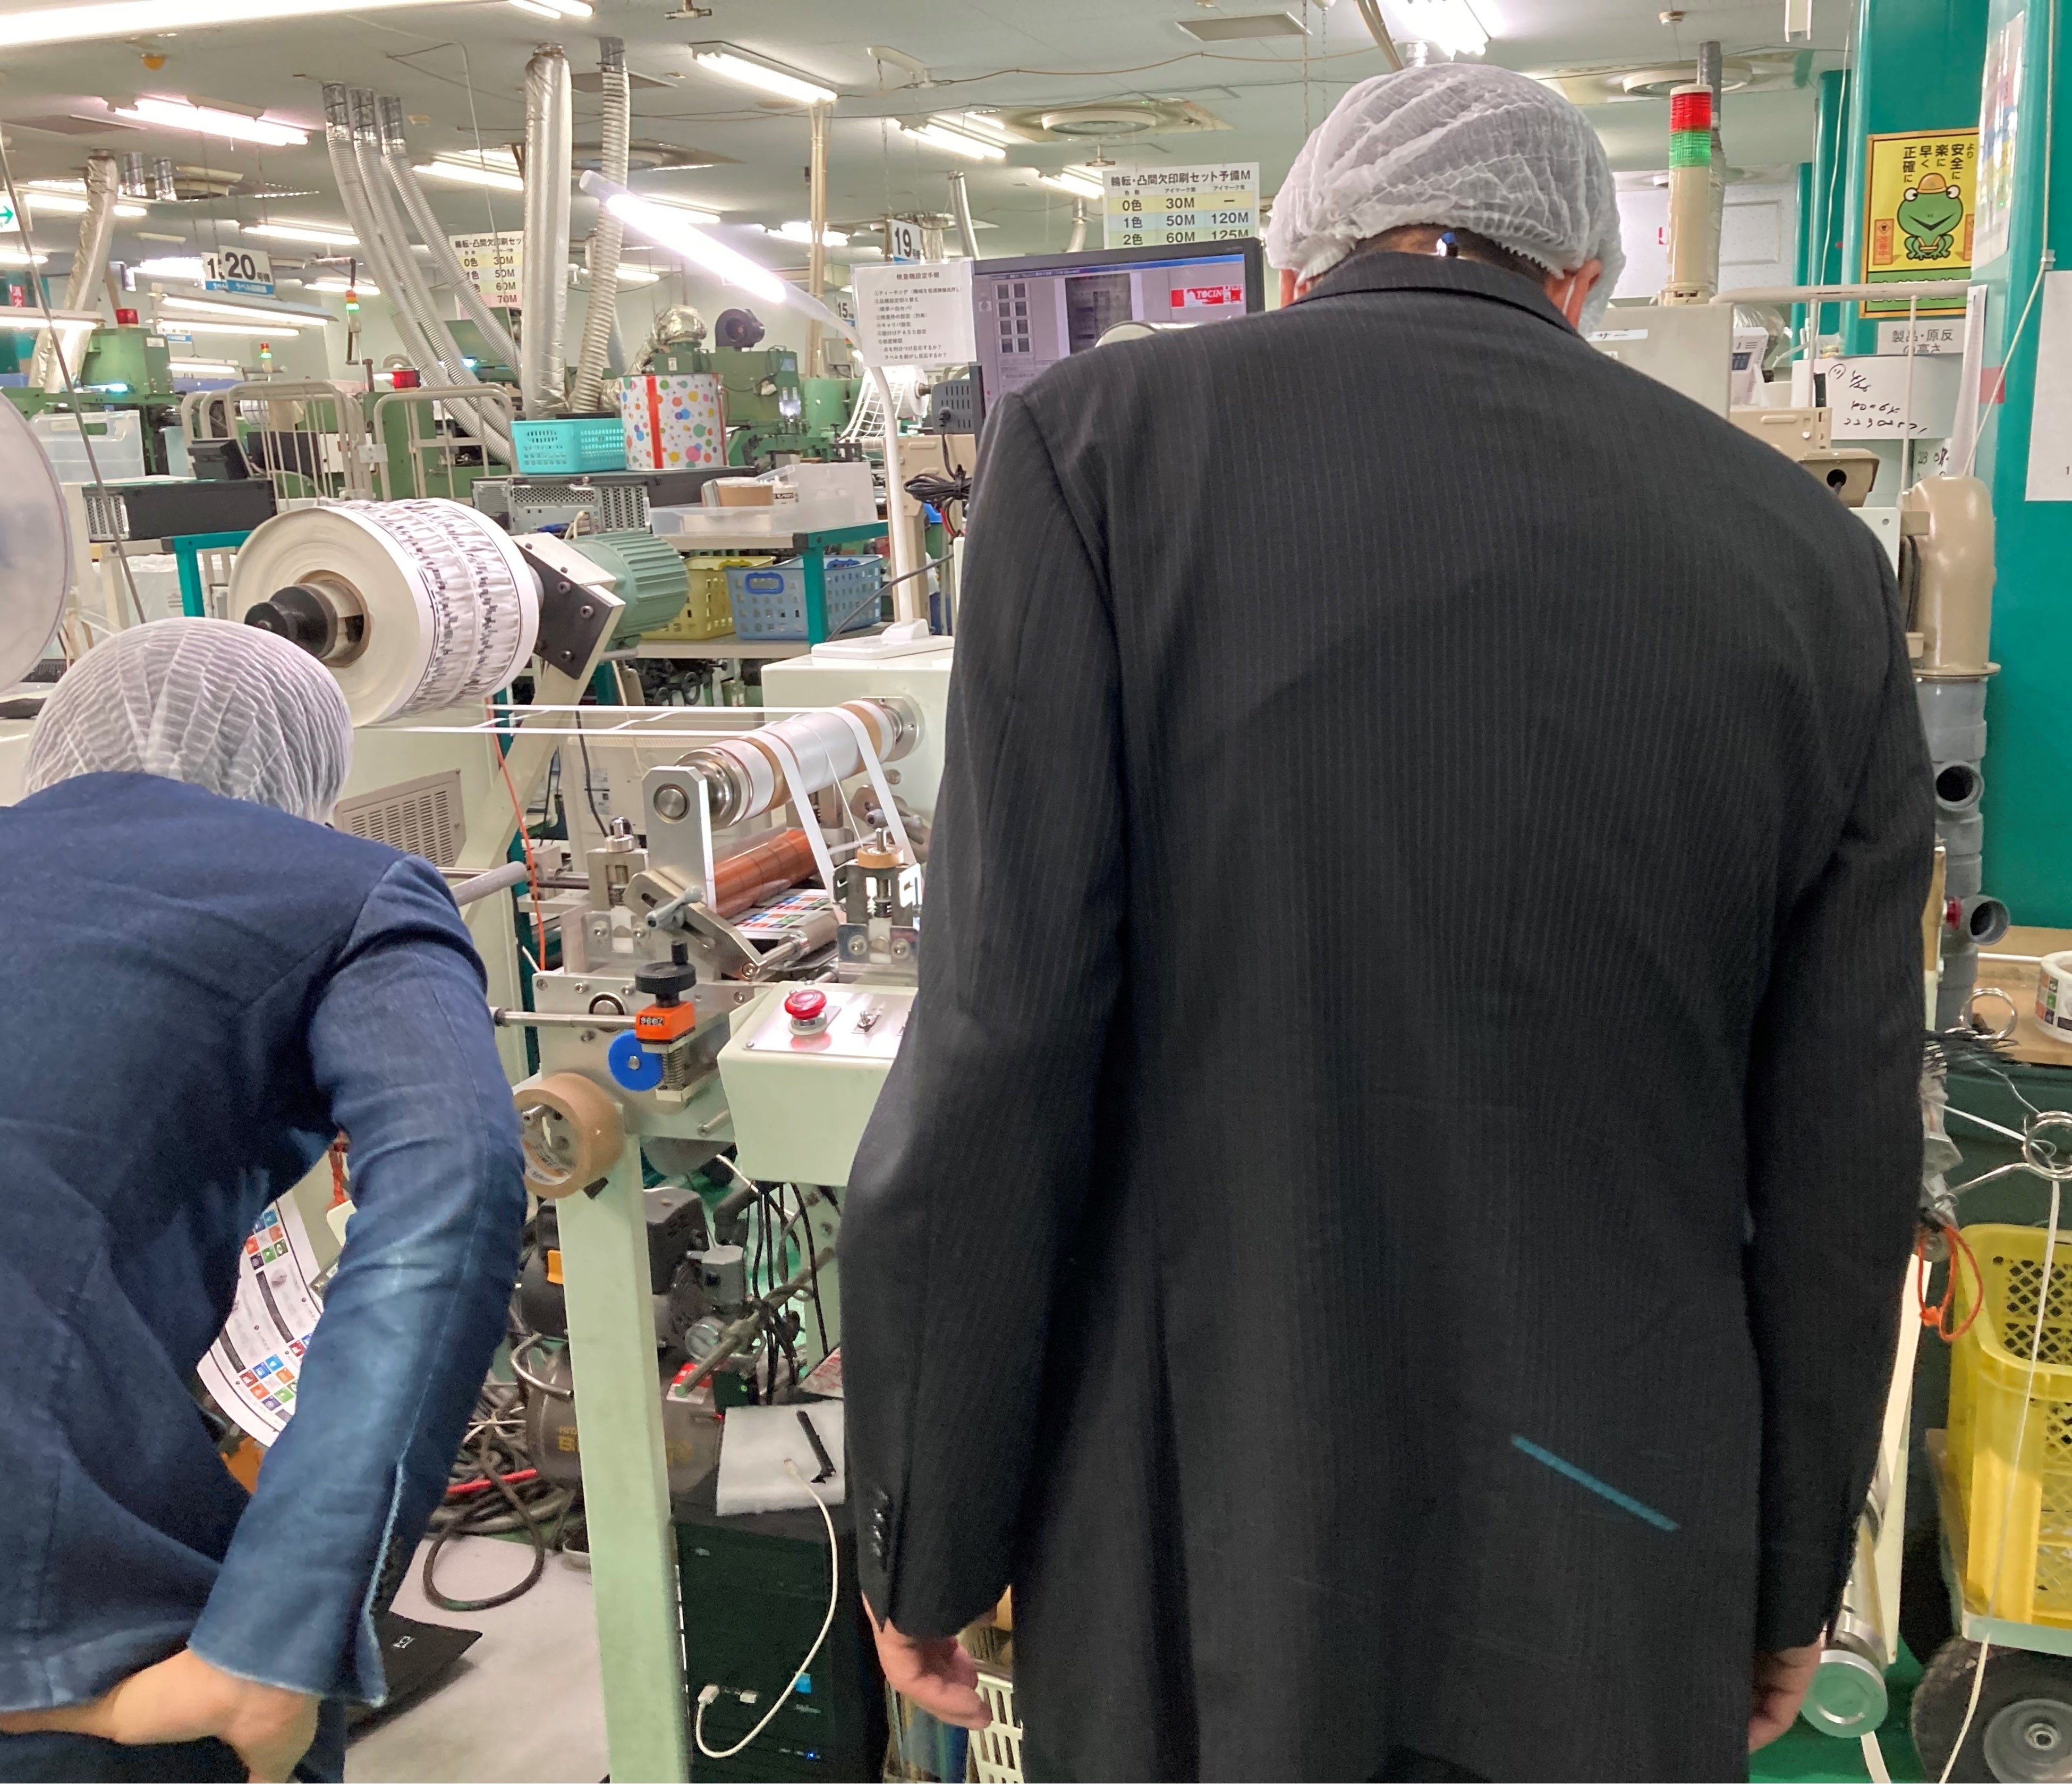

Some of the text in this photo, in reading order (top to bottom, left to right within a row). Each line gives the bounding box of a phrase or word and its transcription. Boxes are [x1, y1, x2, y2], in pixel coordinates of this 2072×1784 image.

[1920, 145, 1933, 168] 早く
[1935, 144, 1949, 167] 楽に
[1966, 143, 1975, 159] より
[1903, 146, 1917, 183] 正確に
[1950, 143, 1965, 180] 安全に
[1122, 199, 1142, 212] 0色
[1166, 197, 1195, 209] 30M
[1124, 212, 1249, 229] 1色 50M 120M
[1123, 233, 1143, 246] 2色
[1166, 232, 1195, 243] 60M
[464, 256, 513, 267] 0色 30M
[495, 269, 515, 278] 50M
[496, 282, 516, 291] 60M
[497, 294, 517, 303] 70M
[1891, 329, 1954, 343] 製品・原反
